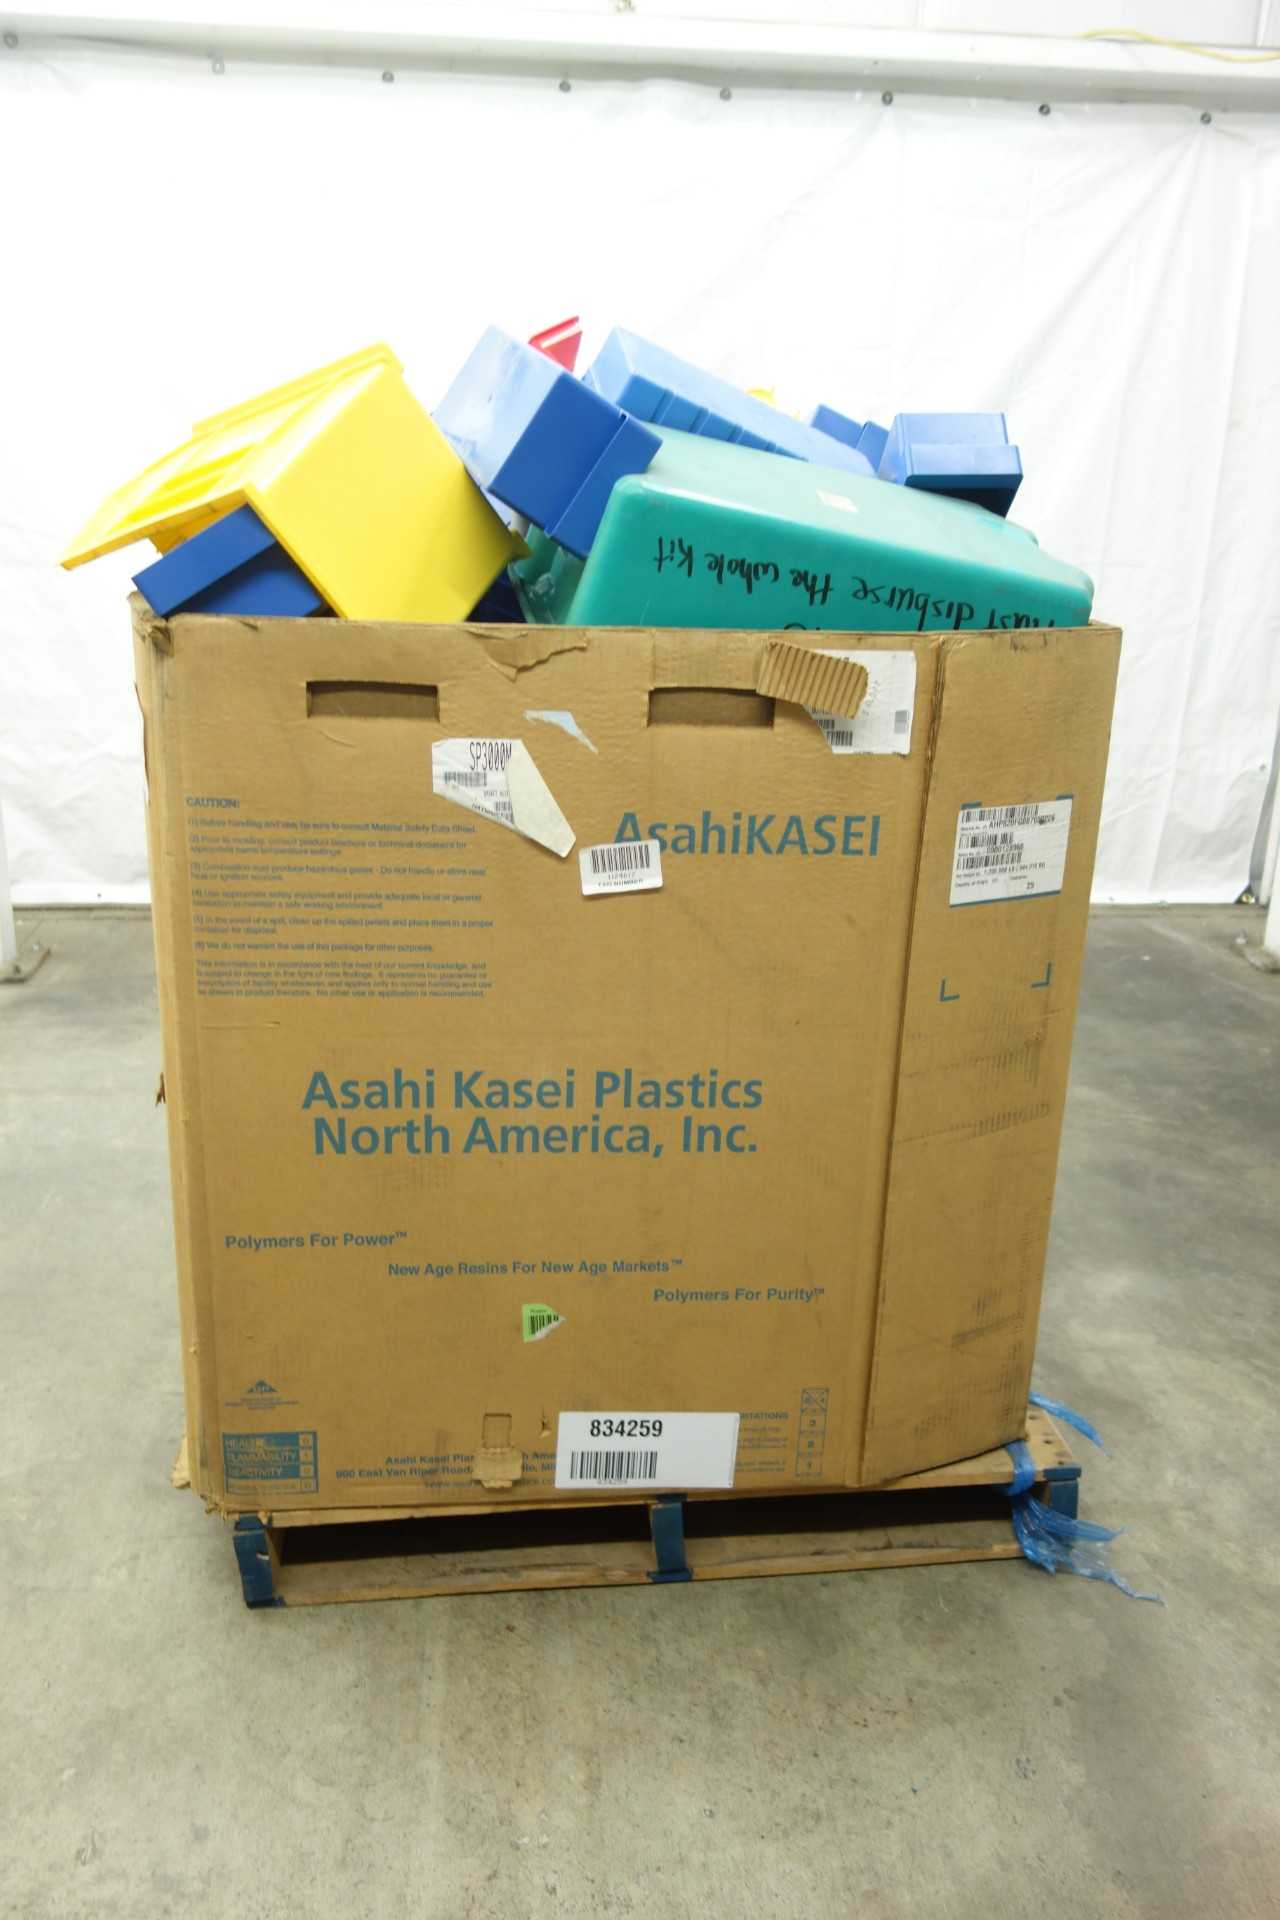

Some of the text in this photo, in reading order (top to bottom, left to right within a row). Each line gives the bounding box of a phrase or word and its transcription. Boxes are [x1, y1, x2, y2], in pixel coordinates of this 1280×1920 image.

[705, 552, 780, 594] whole
[789, 568, 834, 606] the
[851, 575, 974, 632] disburse
[614, 811, 881, 856] AsahiKASEI
[302, 1068, 763, 1110] Asahi Kasei Plastics
[314, 1114, 758, 1158] North America, Inc.
[225, 1234, 305, 1251] Polymers
[310, 1233, 338, 1247] For
[388, 1263, 419, 1276] New
[425, 1263, 453, 1278] Age
[458, 1261, 508, 1275] Resins
[512, 1260, 536, 1274] For
[541, 1261, 573, 1273] New
[578, 1260, 607, 1276] Age
[653, 1288, 729, 1304] Polymers
[735, 1287, 761, 1301] For
[590, 1419, 663, 1438] 834259
[359, 1469, 383, 1478] East
[386, 1467, 406, 1477] Van
[385, 1455, 417, 1465] Asahi
[420, 1455, 450, 1465] Kasei
